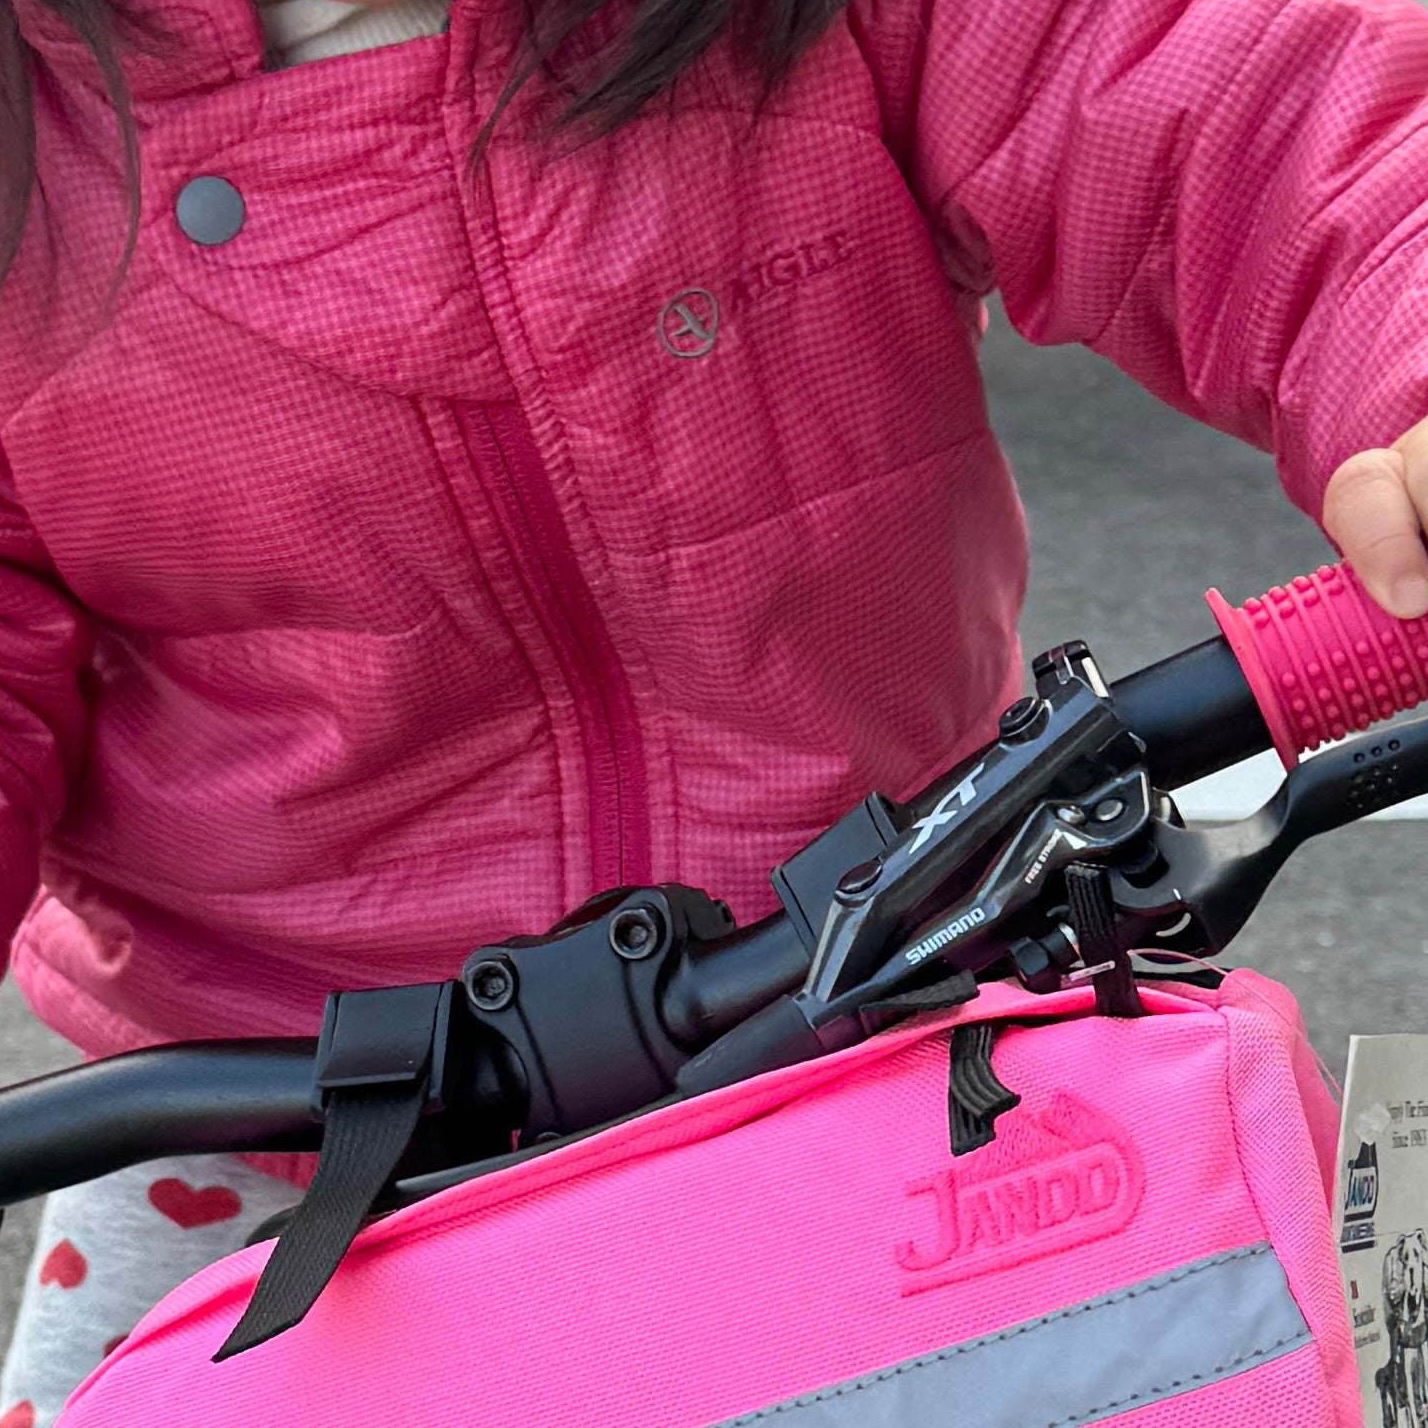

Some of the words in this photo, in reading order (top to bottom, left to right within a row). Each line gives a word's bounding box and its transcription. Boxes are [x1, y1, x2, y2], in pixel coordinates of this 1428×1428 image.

[731, 231, 852, 312] AIGLE
[908, 762, 986, 855] XT
[905, 907, 986, 965] SHIMANO
[895, 1157, 1120, 1271] JANDD
